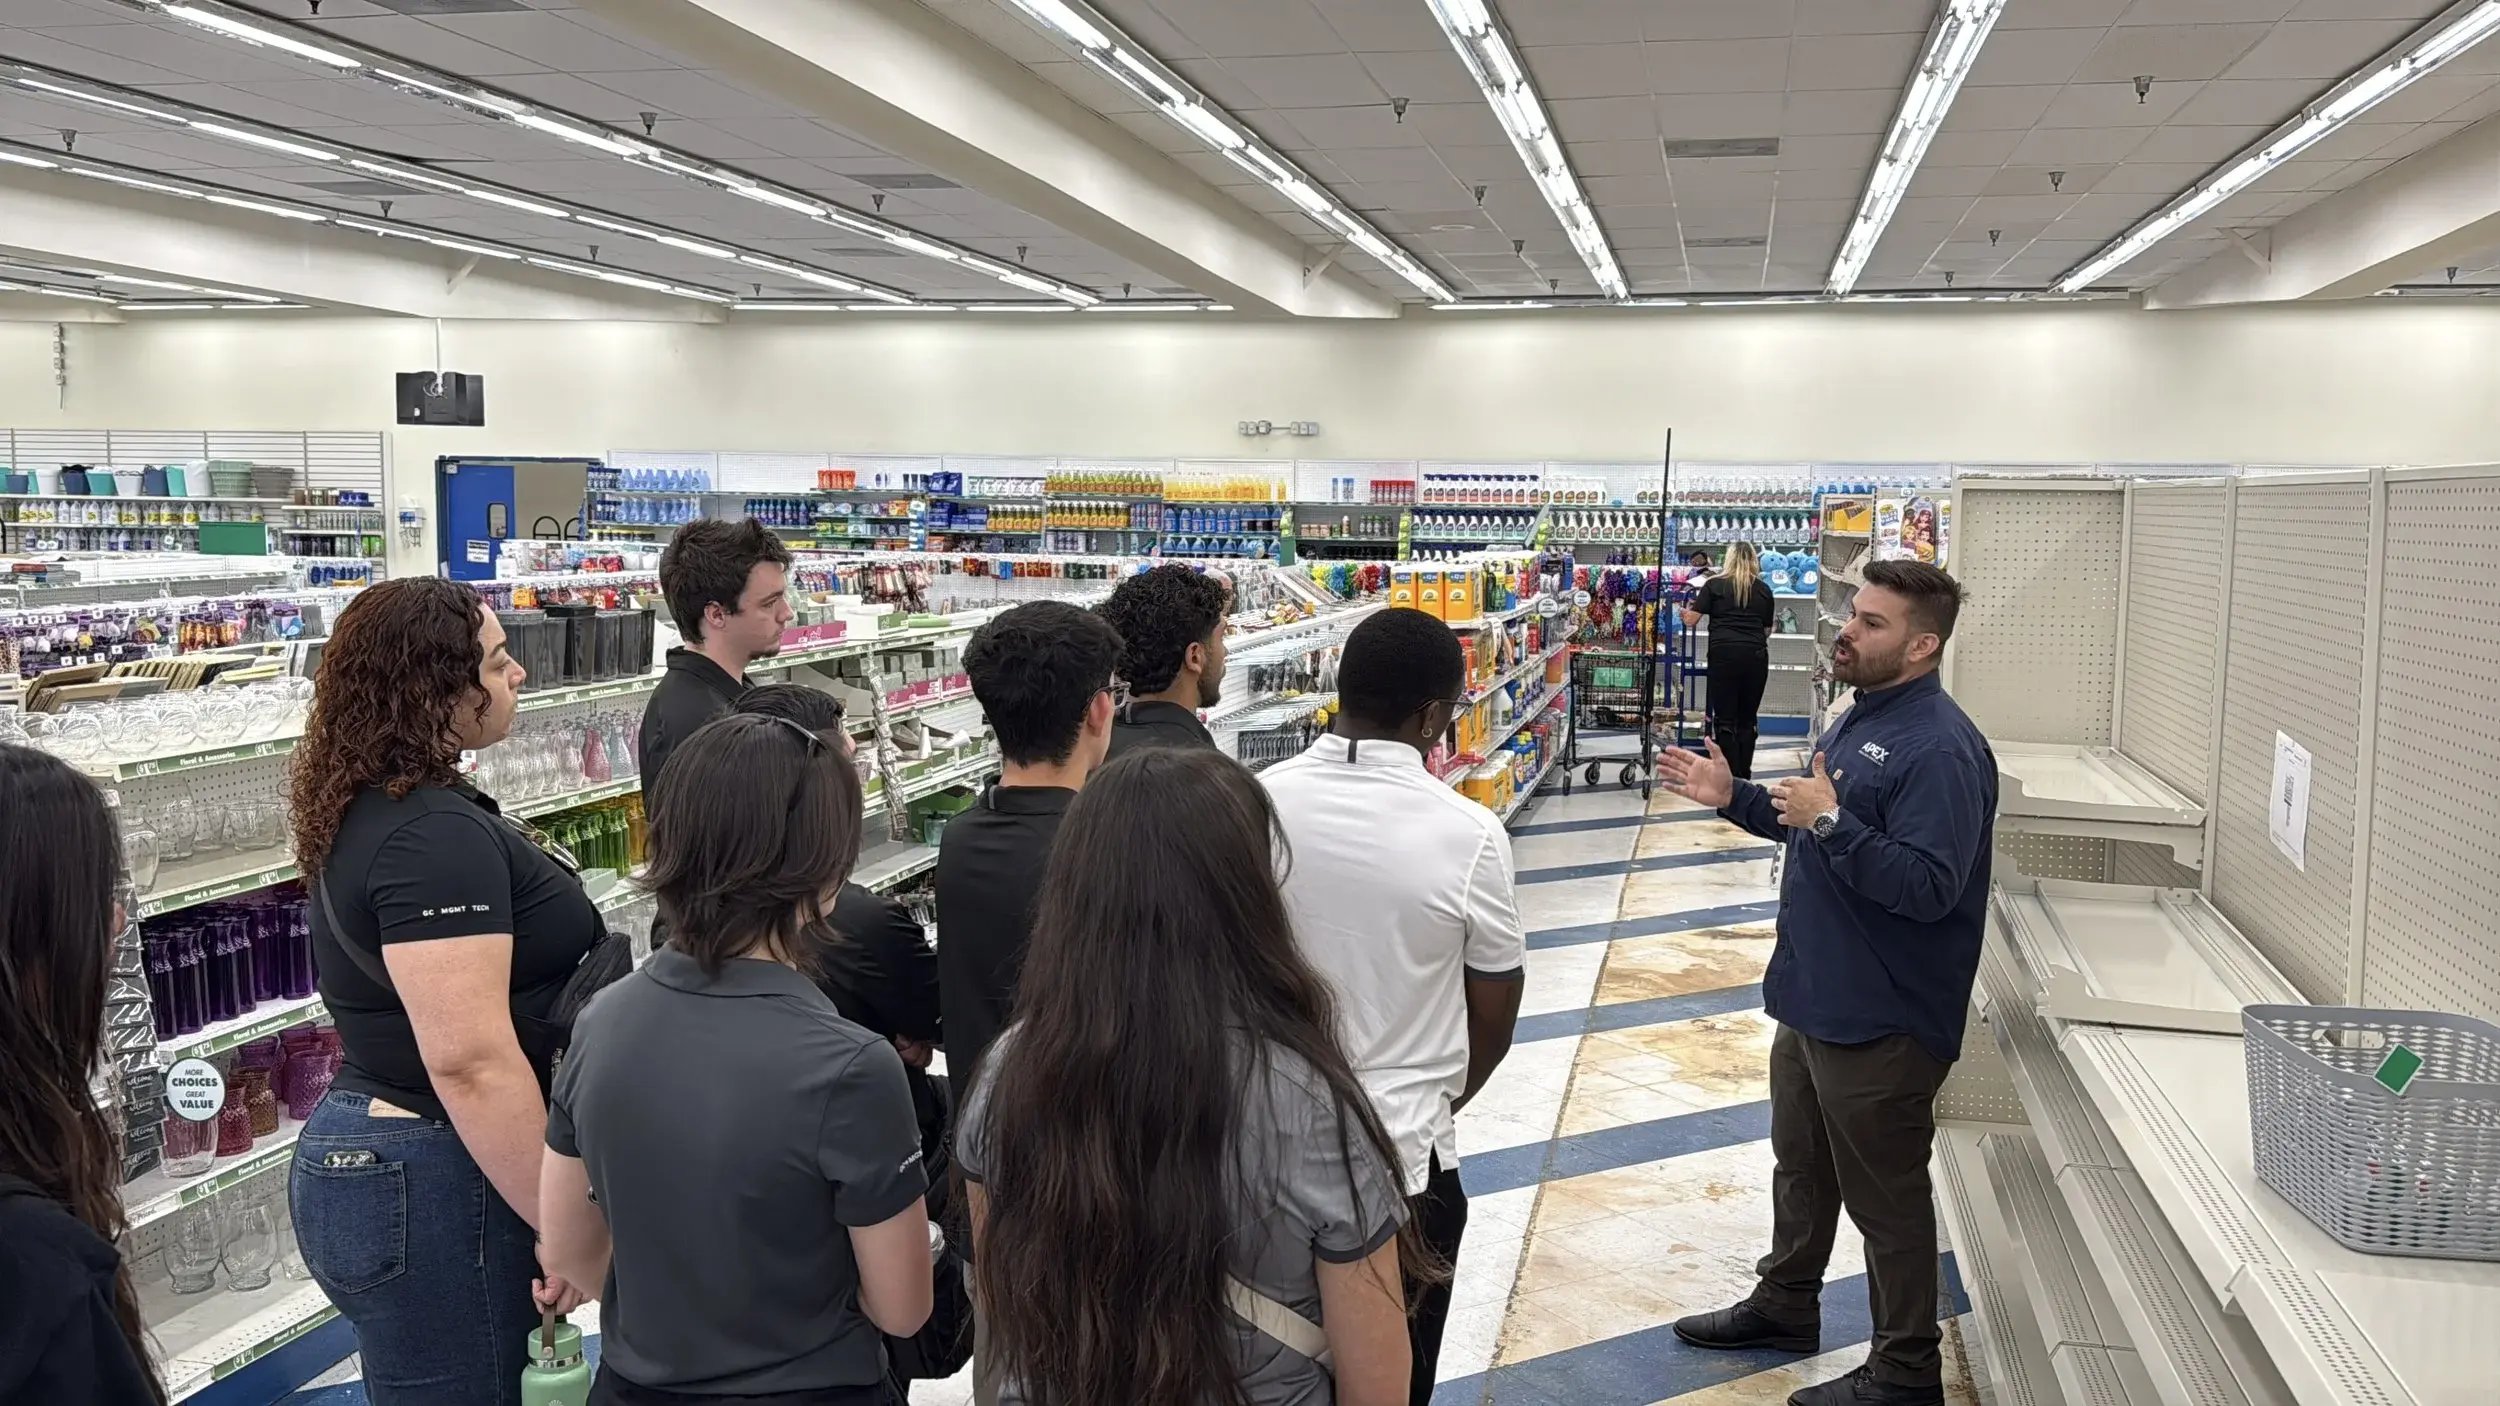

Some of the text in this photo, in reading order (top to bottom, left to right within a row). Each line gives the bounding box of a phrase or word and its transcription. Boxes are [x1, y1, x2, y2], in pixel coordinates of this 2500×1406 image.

[1861, 742, 1890, 762] APEX
[422, 909, 435, 917] GC
[441, 905, 466, 914] MGMT
[172, 1078, 218, 1087] CHOICES
[179, 1100, 214, 1109] VALUE
